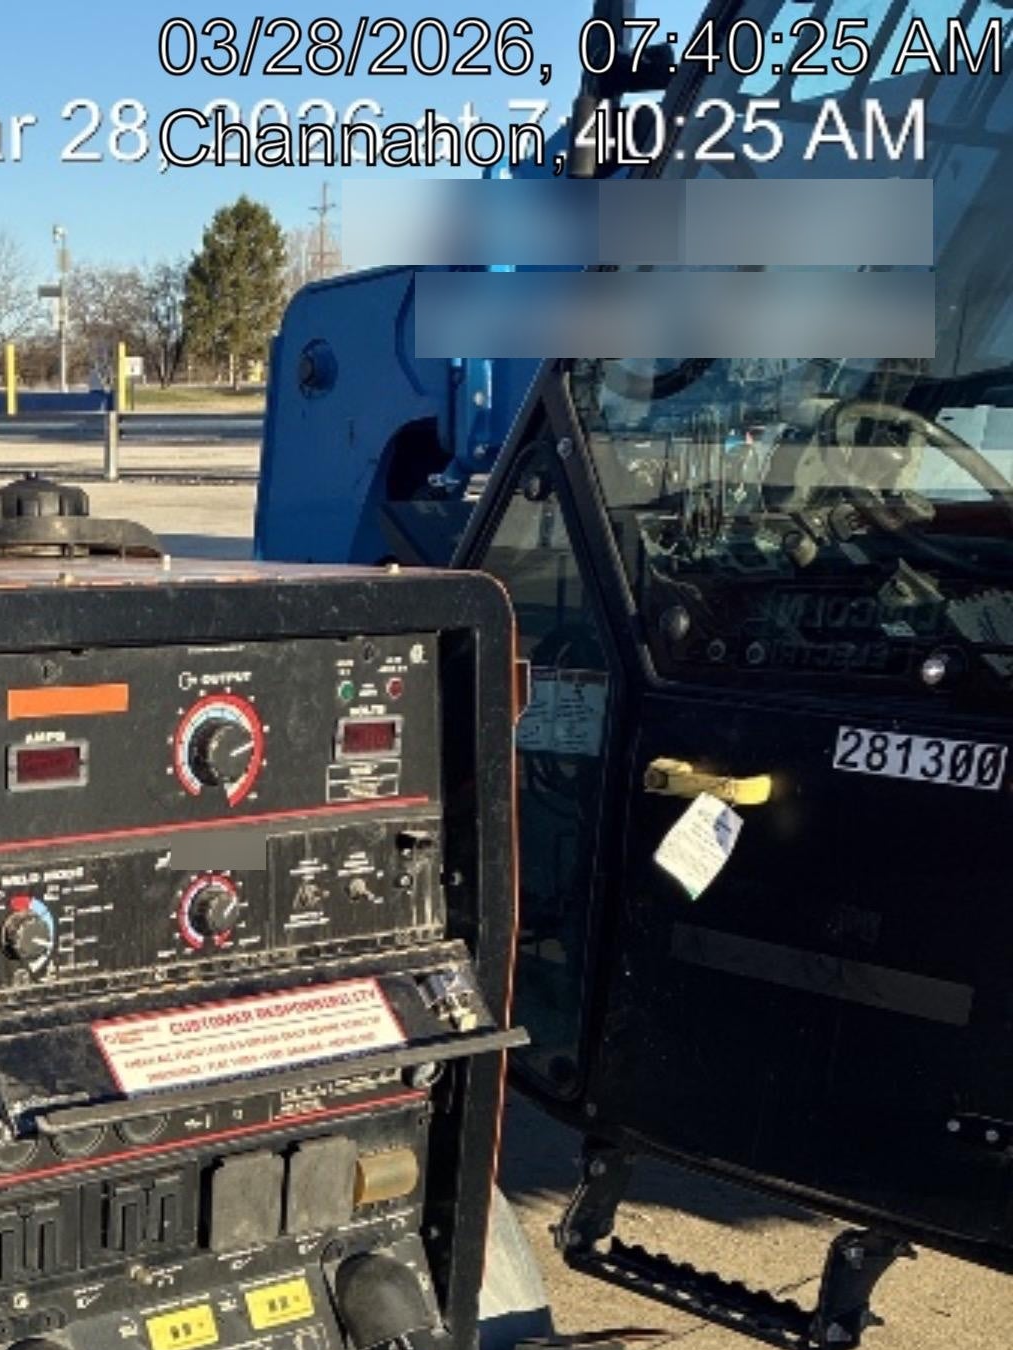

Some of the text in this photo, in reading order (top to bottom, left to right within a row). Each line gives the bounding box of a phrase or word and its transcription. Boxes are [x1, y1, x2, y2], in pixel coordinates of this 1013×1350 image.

[835, 730, 1003, 786] 281300
[169, 1010, 252, 1036] CUSTOMER
[255, 989, 376, 1020] RESPONSIBILITY
